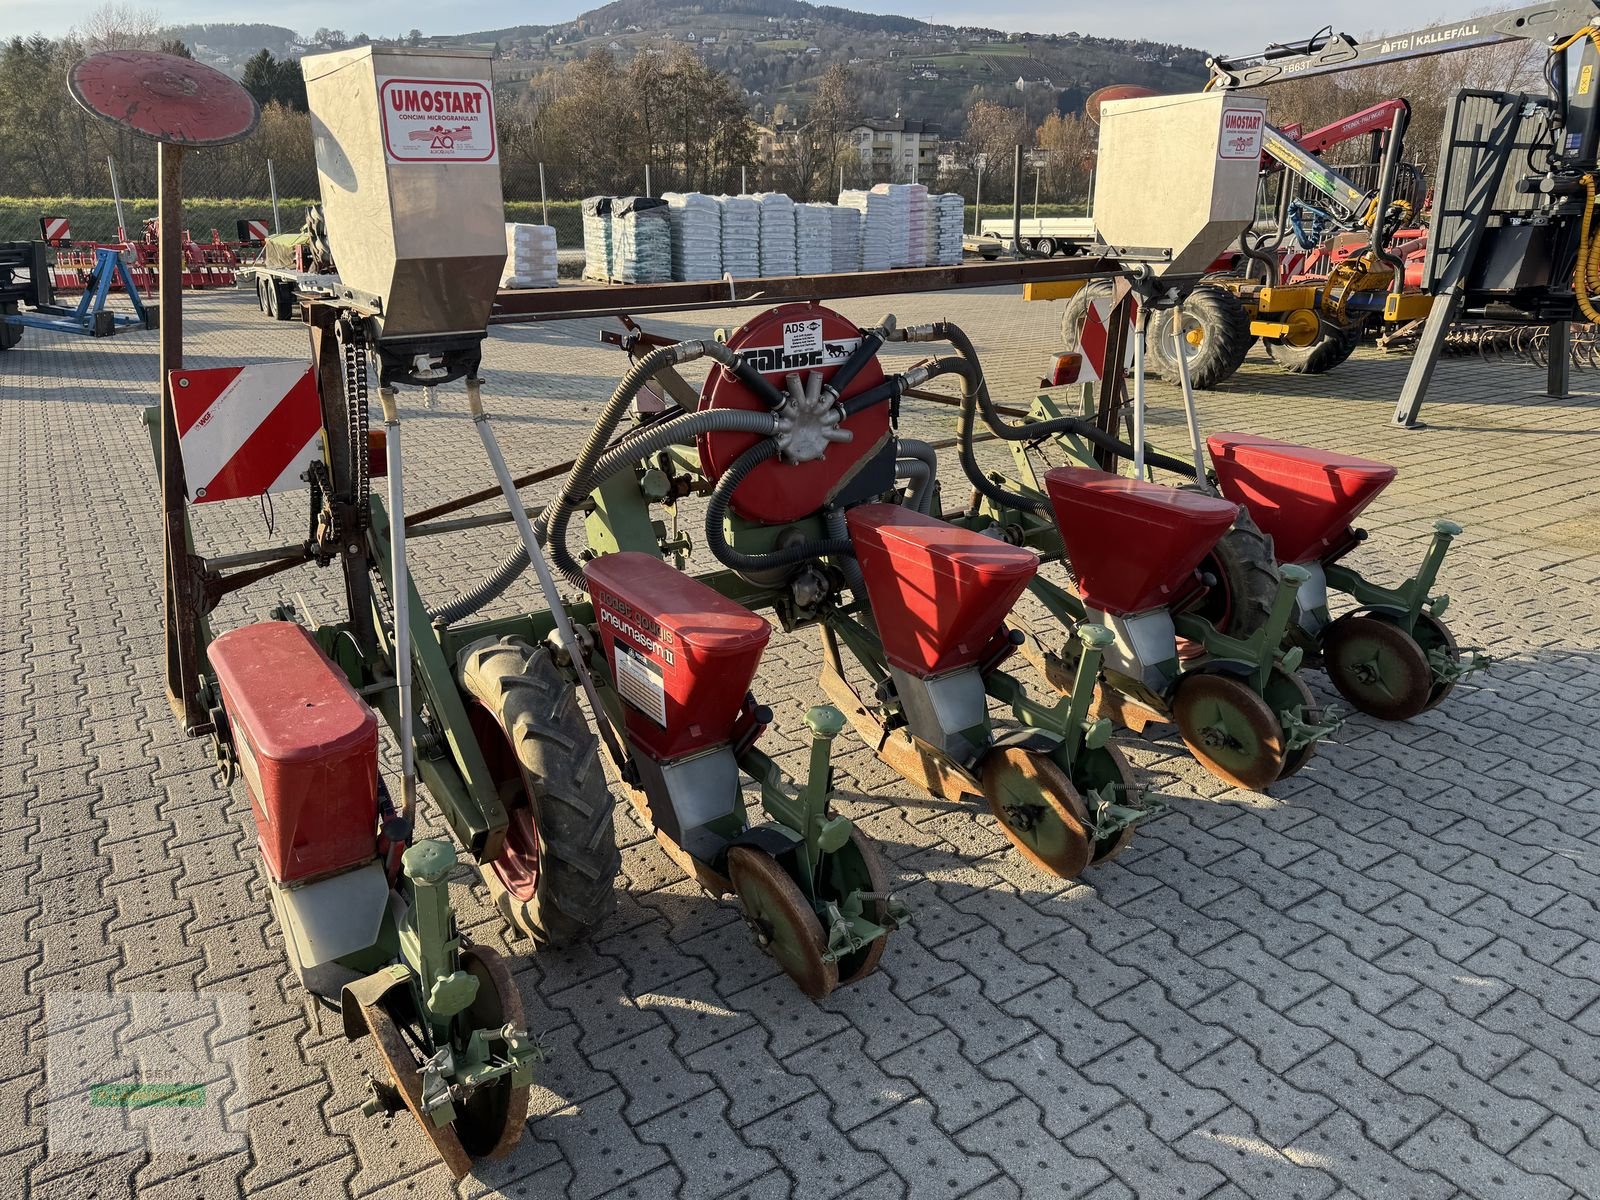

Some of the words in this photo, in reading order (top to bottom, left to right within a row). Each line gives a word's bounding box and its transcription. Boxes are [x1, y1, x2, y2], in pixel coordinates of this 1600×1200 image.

[1390, 40, 1409, 52] FTG
[390, 89, 482, 113] UMOSTART
[1225, 115, 1261, 129] UMOSTART
[785, 323, 804, 334] ADS
[199, 411, 211, 426] WGF
[601, 607, 664, 659] pneumasem
